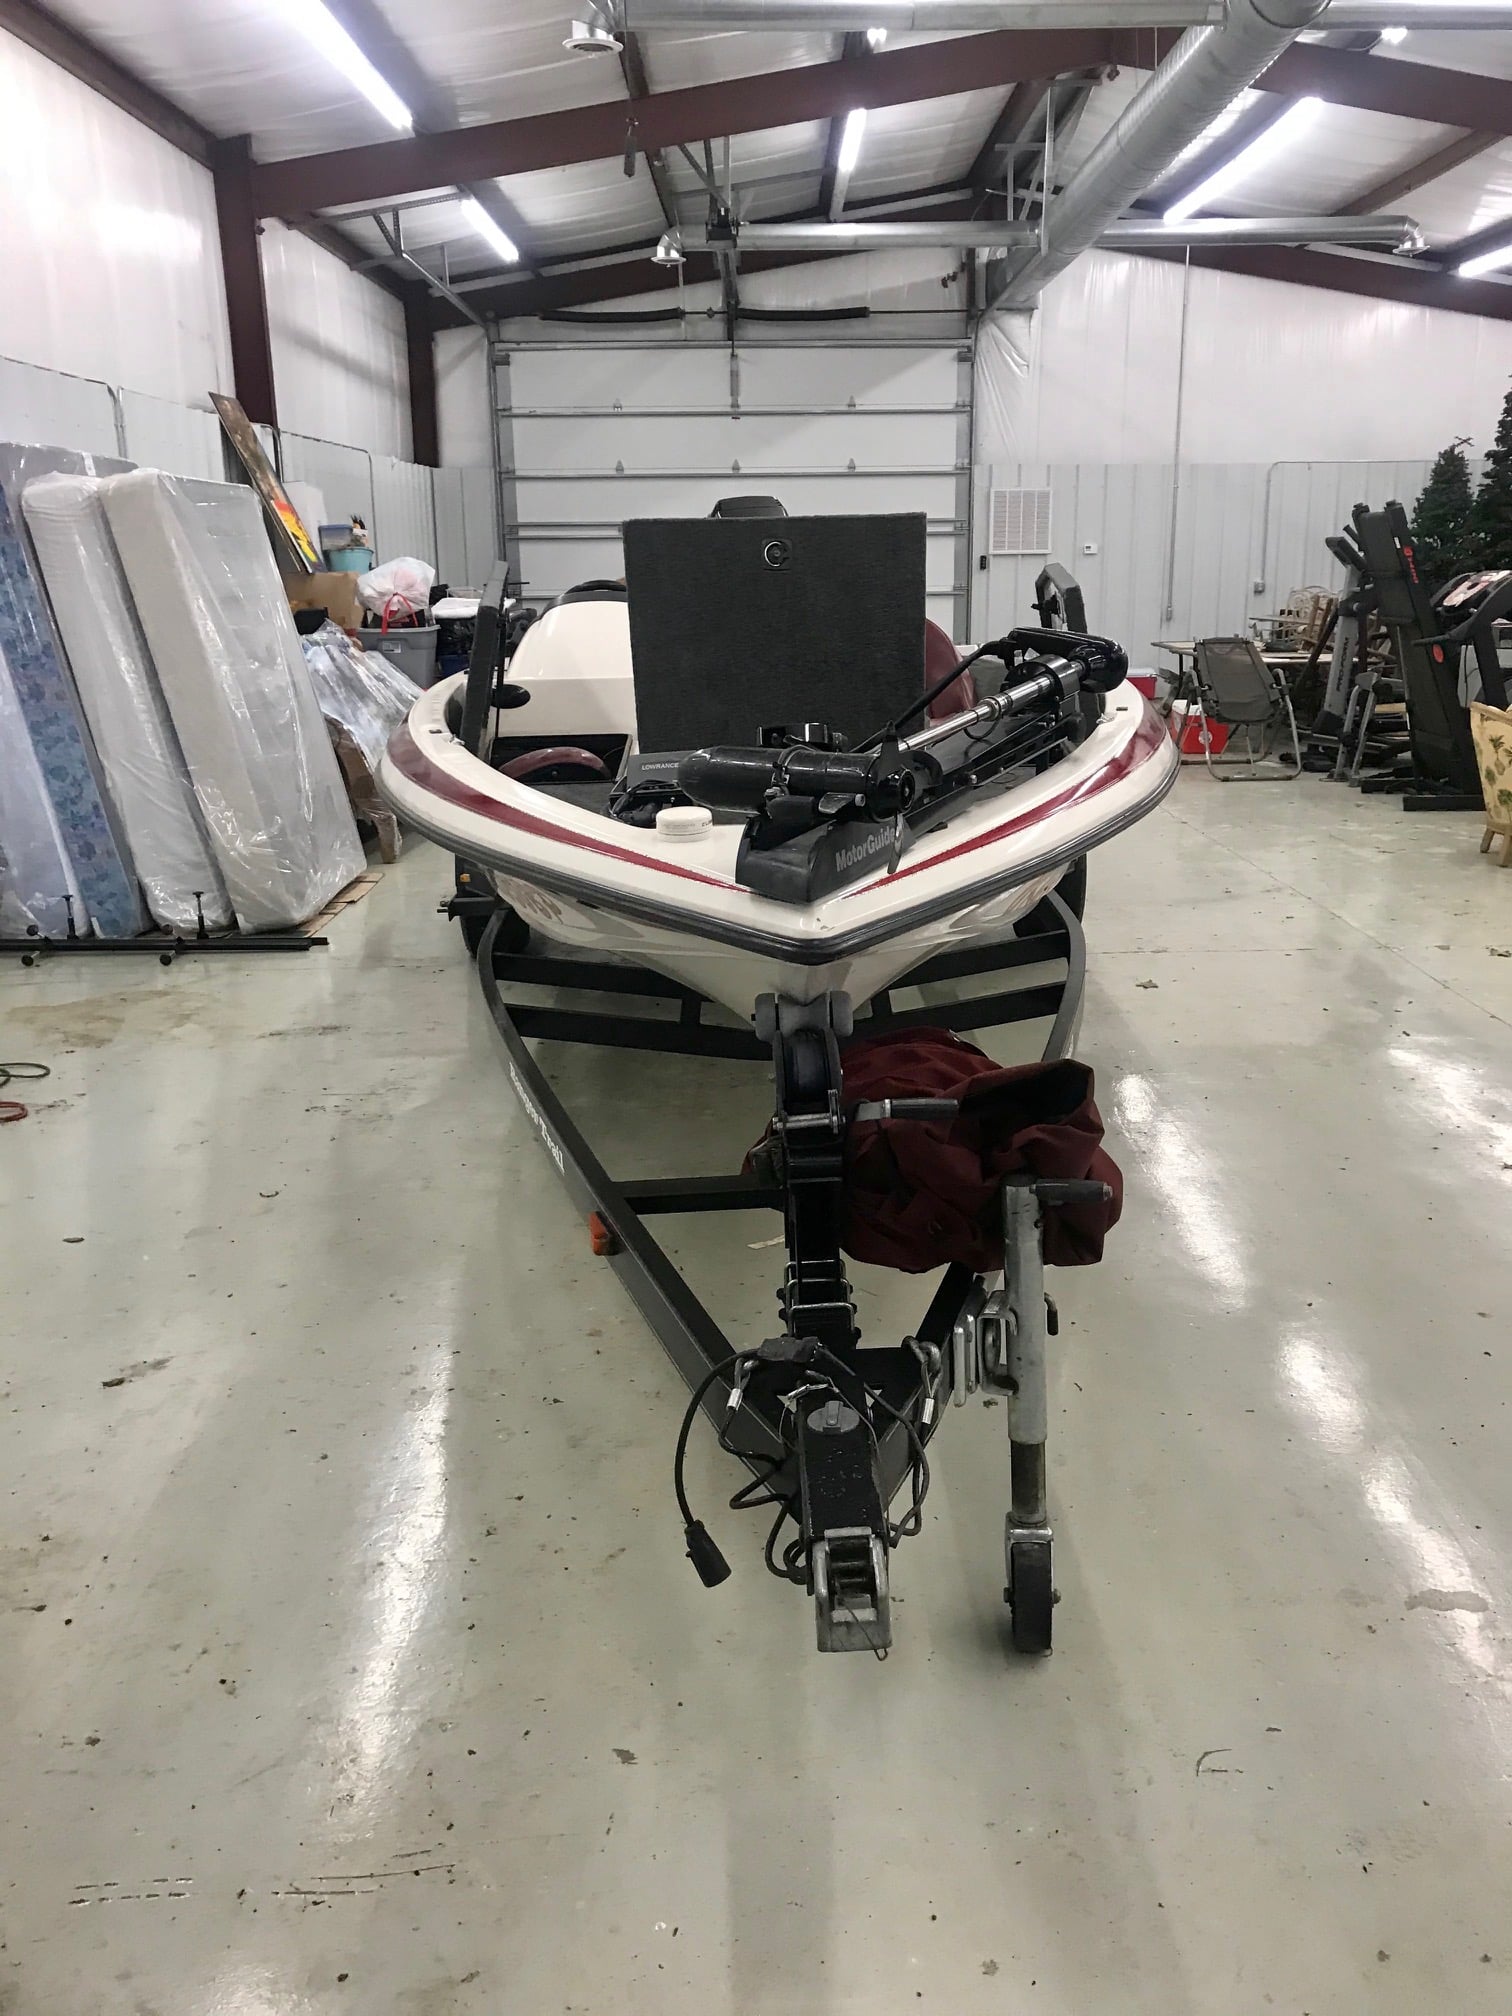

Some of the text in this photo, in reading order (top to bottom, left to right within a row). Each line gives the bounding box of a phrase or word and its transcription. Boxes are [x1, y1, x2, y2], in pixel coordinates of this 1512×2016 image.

[641, 762, 679, 770] LOWRANCE
[835, 826, 896, 872] MotorGuide
[539, 1116, 565, 1176] Trail
